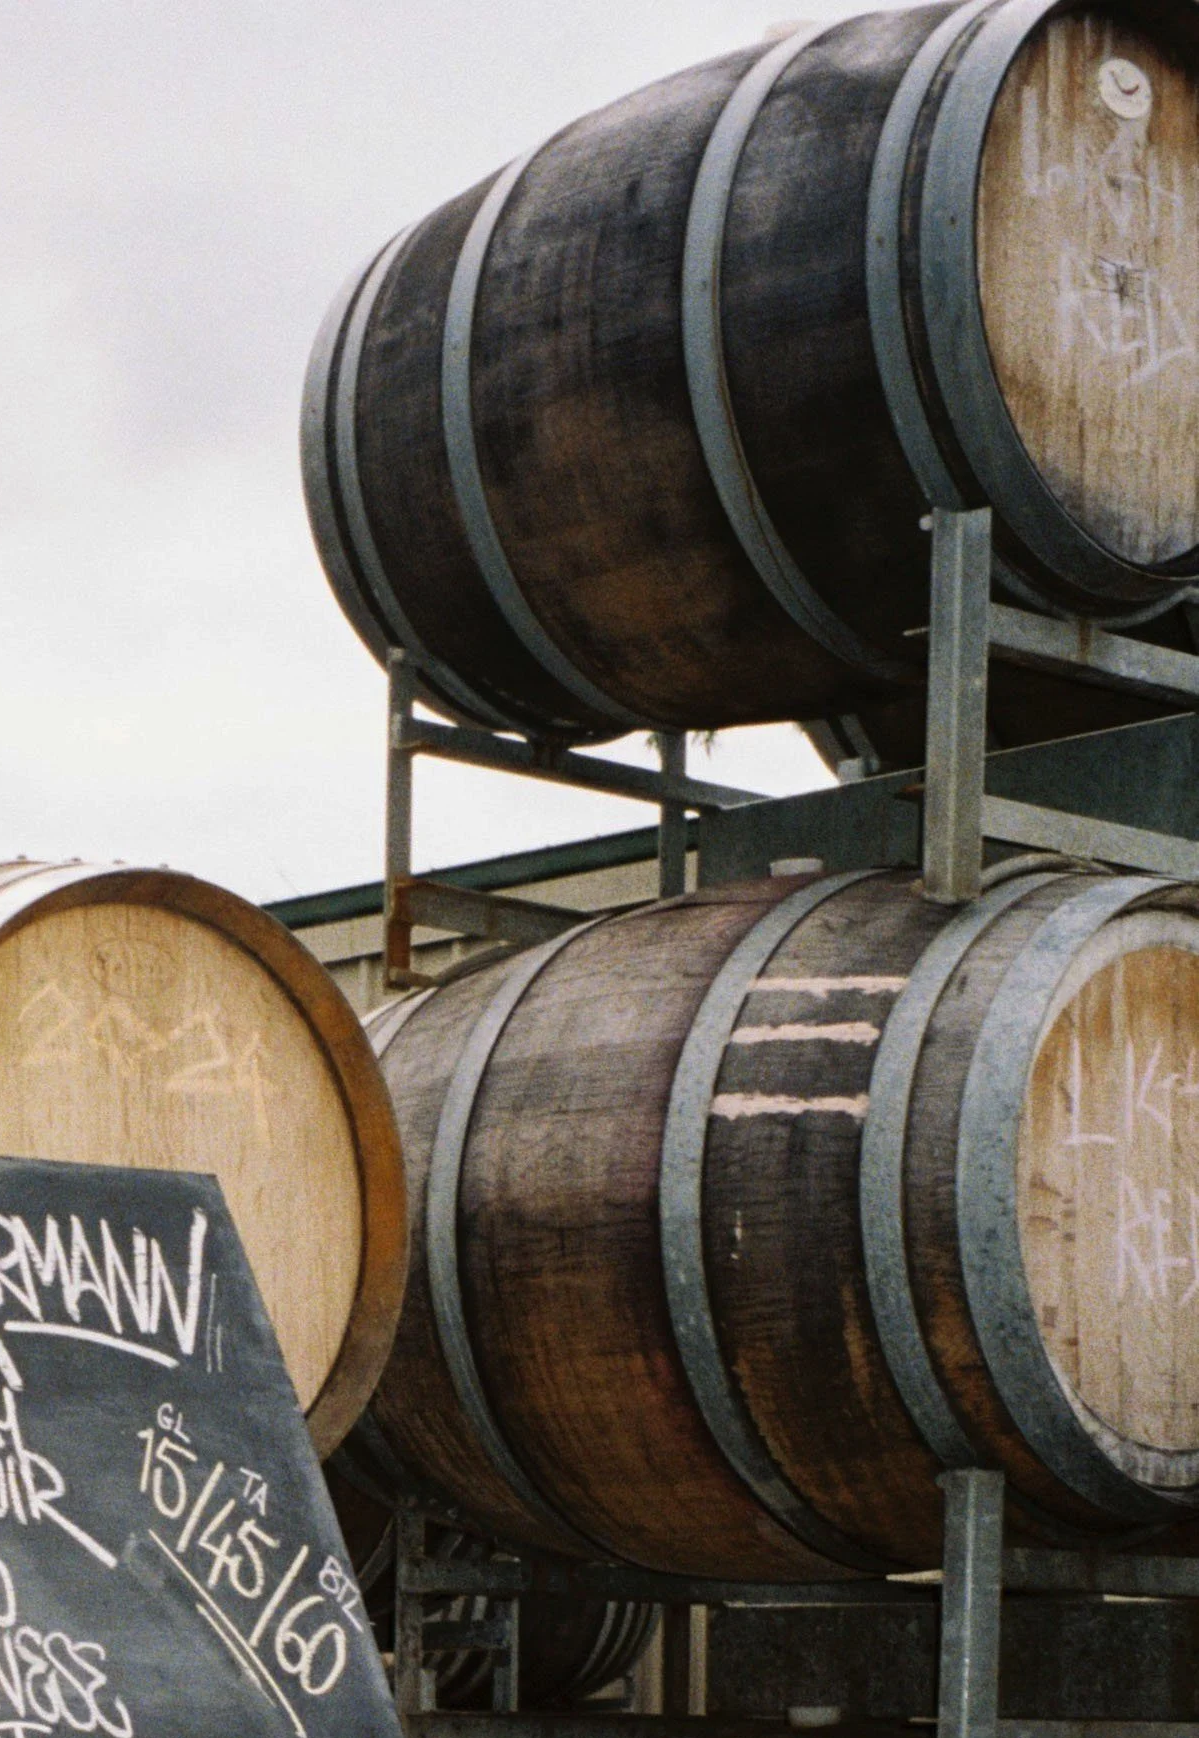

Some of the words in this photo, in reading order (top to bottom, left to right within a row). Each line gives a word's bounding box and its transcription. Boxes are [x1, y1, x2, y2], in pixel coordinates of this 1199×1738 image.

[156, 1402, 192, 1444] GL
[239, 1467, 269, 1517] TA
[318, 1554, 365, 1634] BTL
